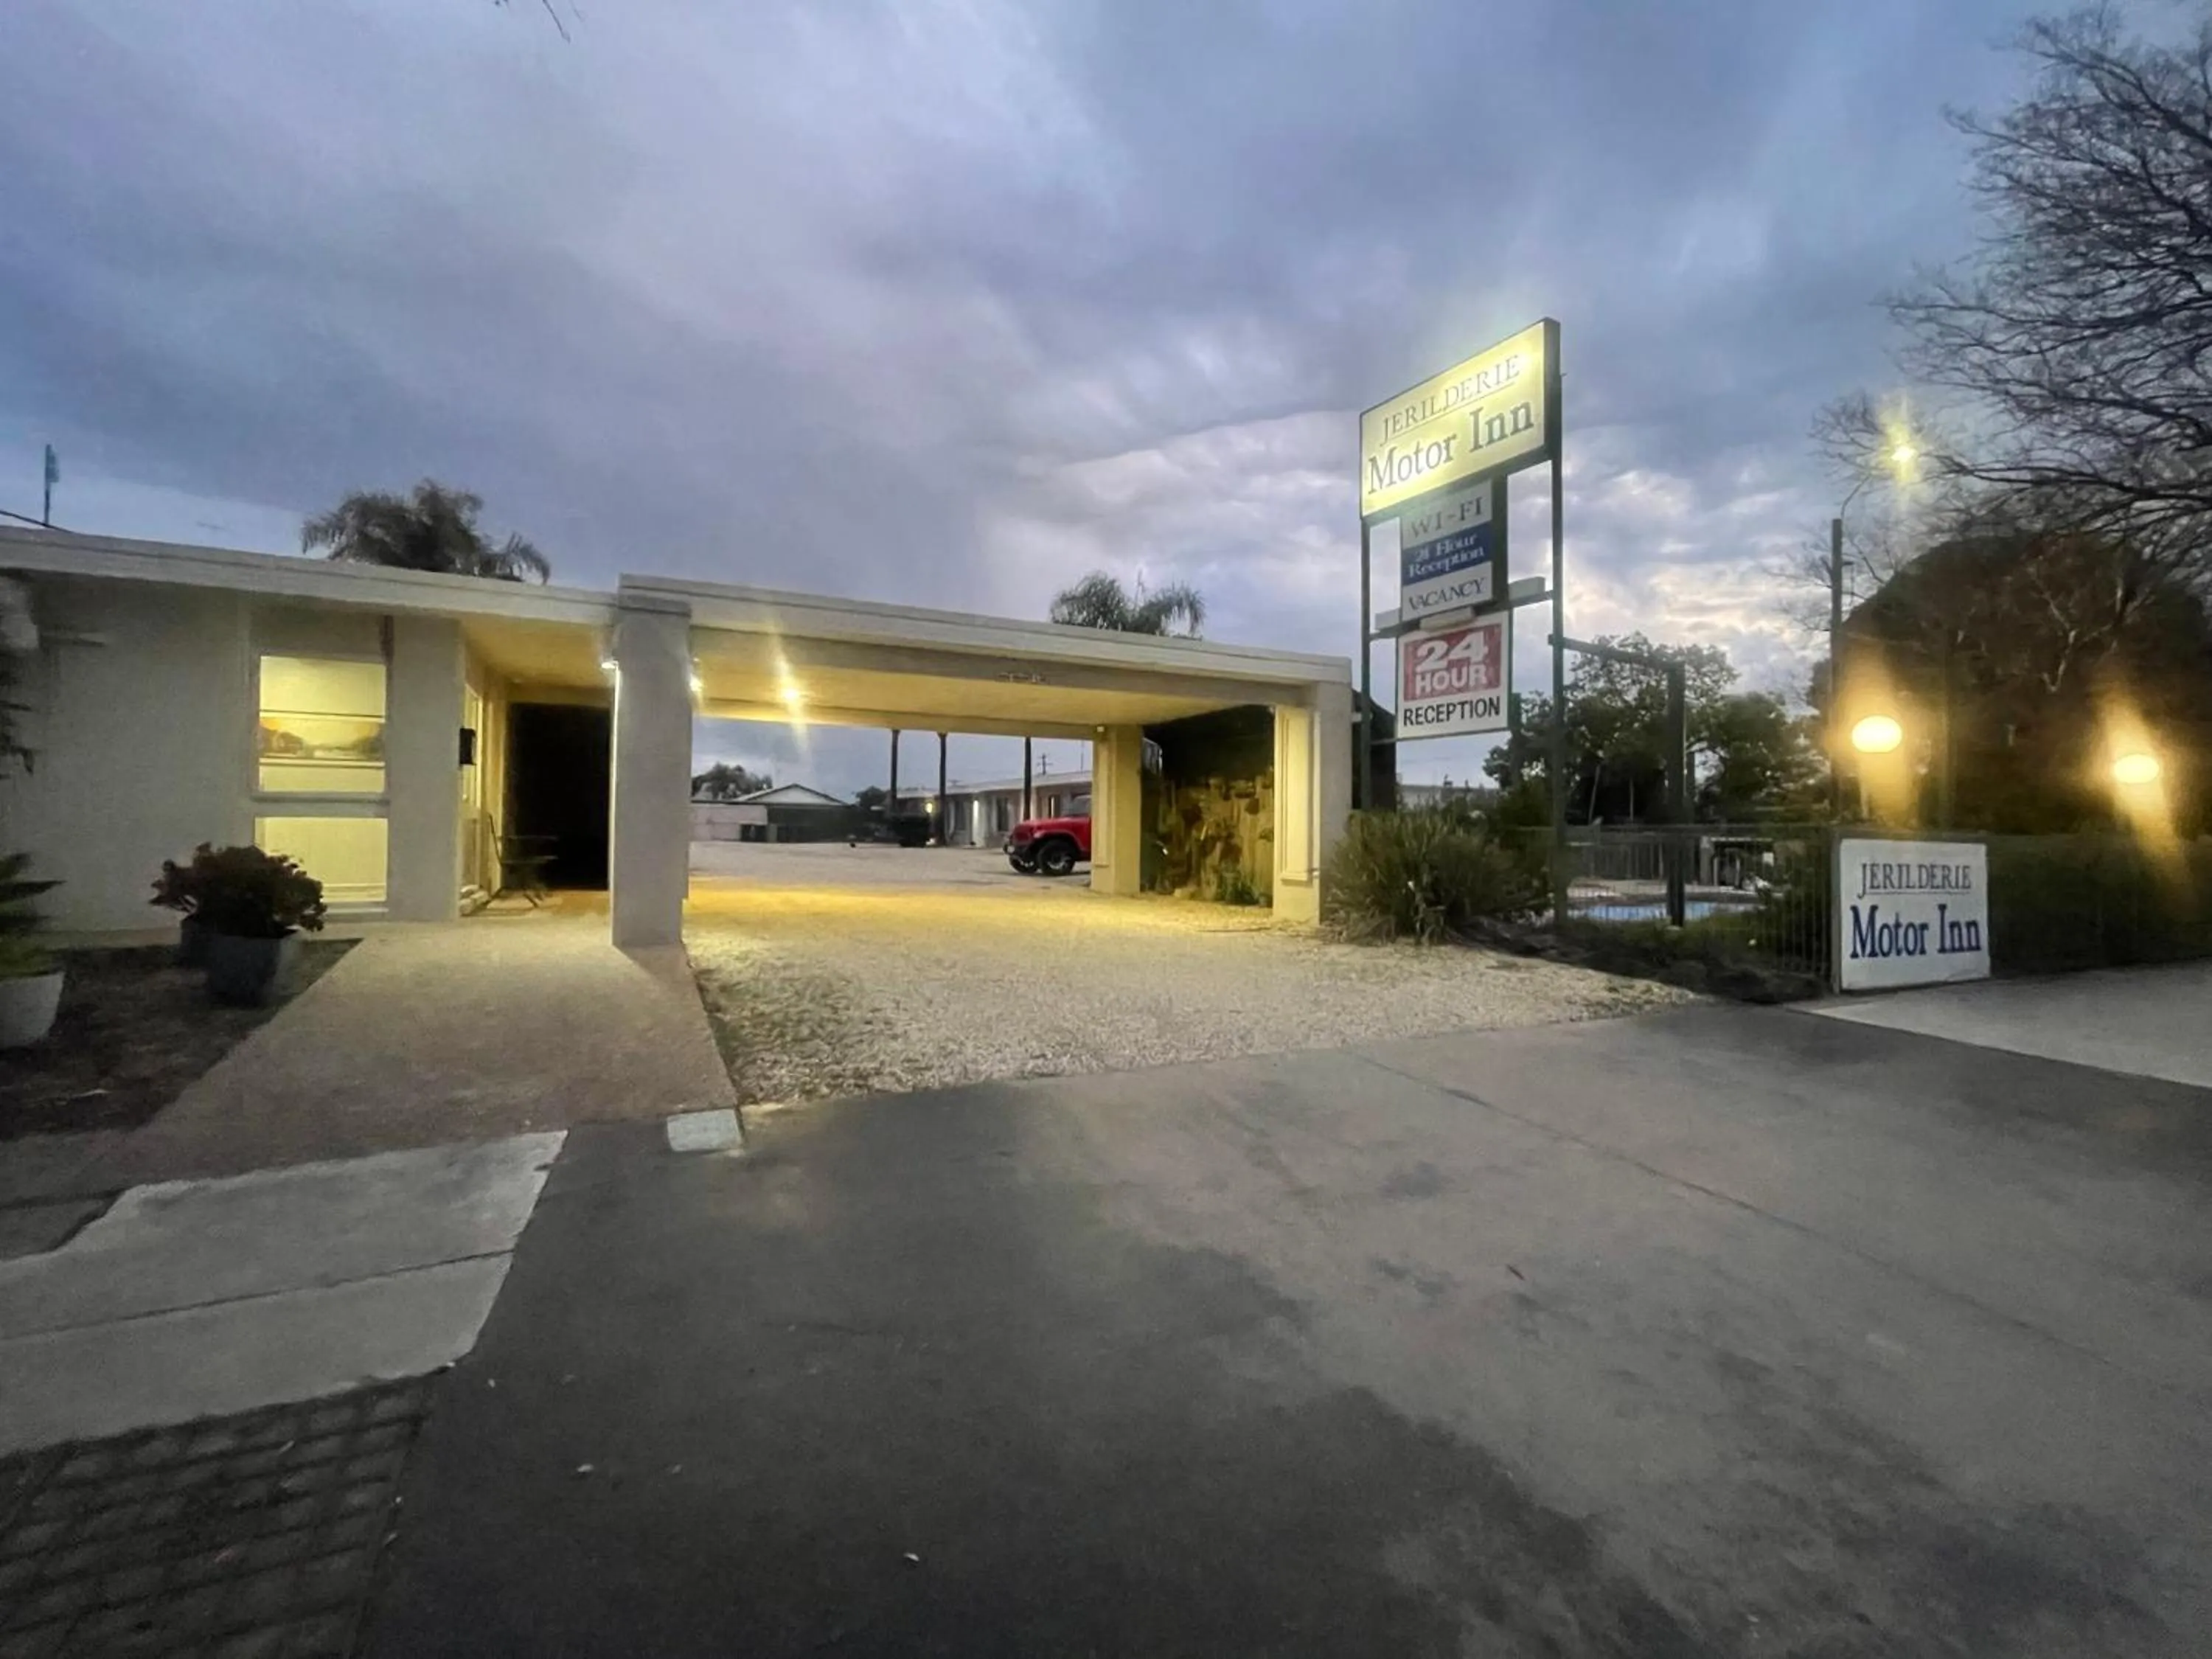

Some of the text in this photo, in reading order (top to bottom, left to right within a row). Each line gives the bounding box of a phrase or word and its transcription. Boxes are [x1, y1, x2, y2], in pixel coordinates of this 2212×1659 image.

[1380, 355, 1520, 447] JERILDERIE
[1368, 401, 1534, 495] Motor Inn
[1411, 496, 1483, 538] WI-FI
[1408, 546, 1484, 578] Reception
[1436, 534, 1477, 555] Hour
[1409, 577, 1486, 611] VACANCY
[1415, 631, 1489, 673] 24
[1415, 664, 1488, 698] HOUR
[1403, 695, 1500, 726] RECEPTION
[1857, 863, 1972, 900] JERILDERIE
[1850, 903, 1982, 959] Motor Inn
